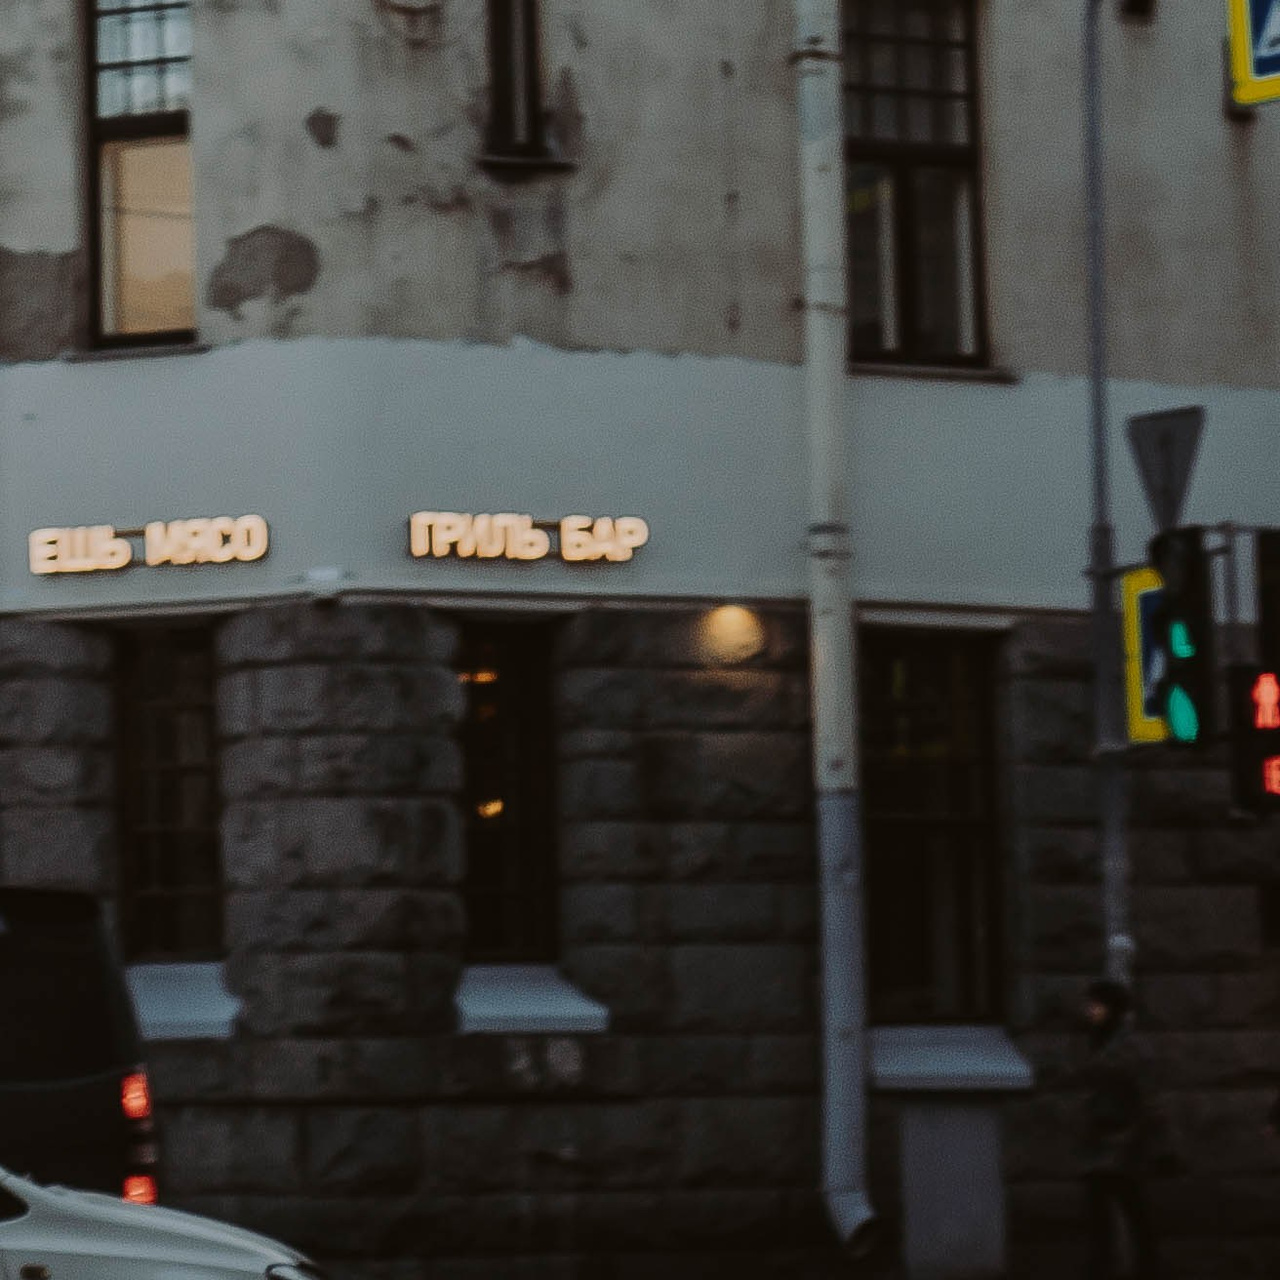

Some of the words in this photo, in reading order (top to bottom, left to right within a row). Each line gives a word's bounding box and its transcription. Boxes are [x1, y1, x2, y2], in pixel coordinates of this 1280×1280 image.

[28, 524, 132, 574] ЕШЬ
[144, 514, 269, 566] МЯСО
[409, 510, 550, 560] ГРИЛЬ
[560, 514, 649, 561] БАР
